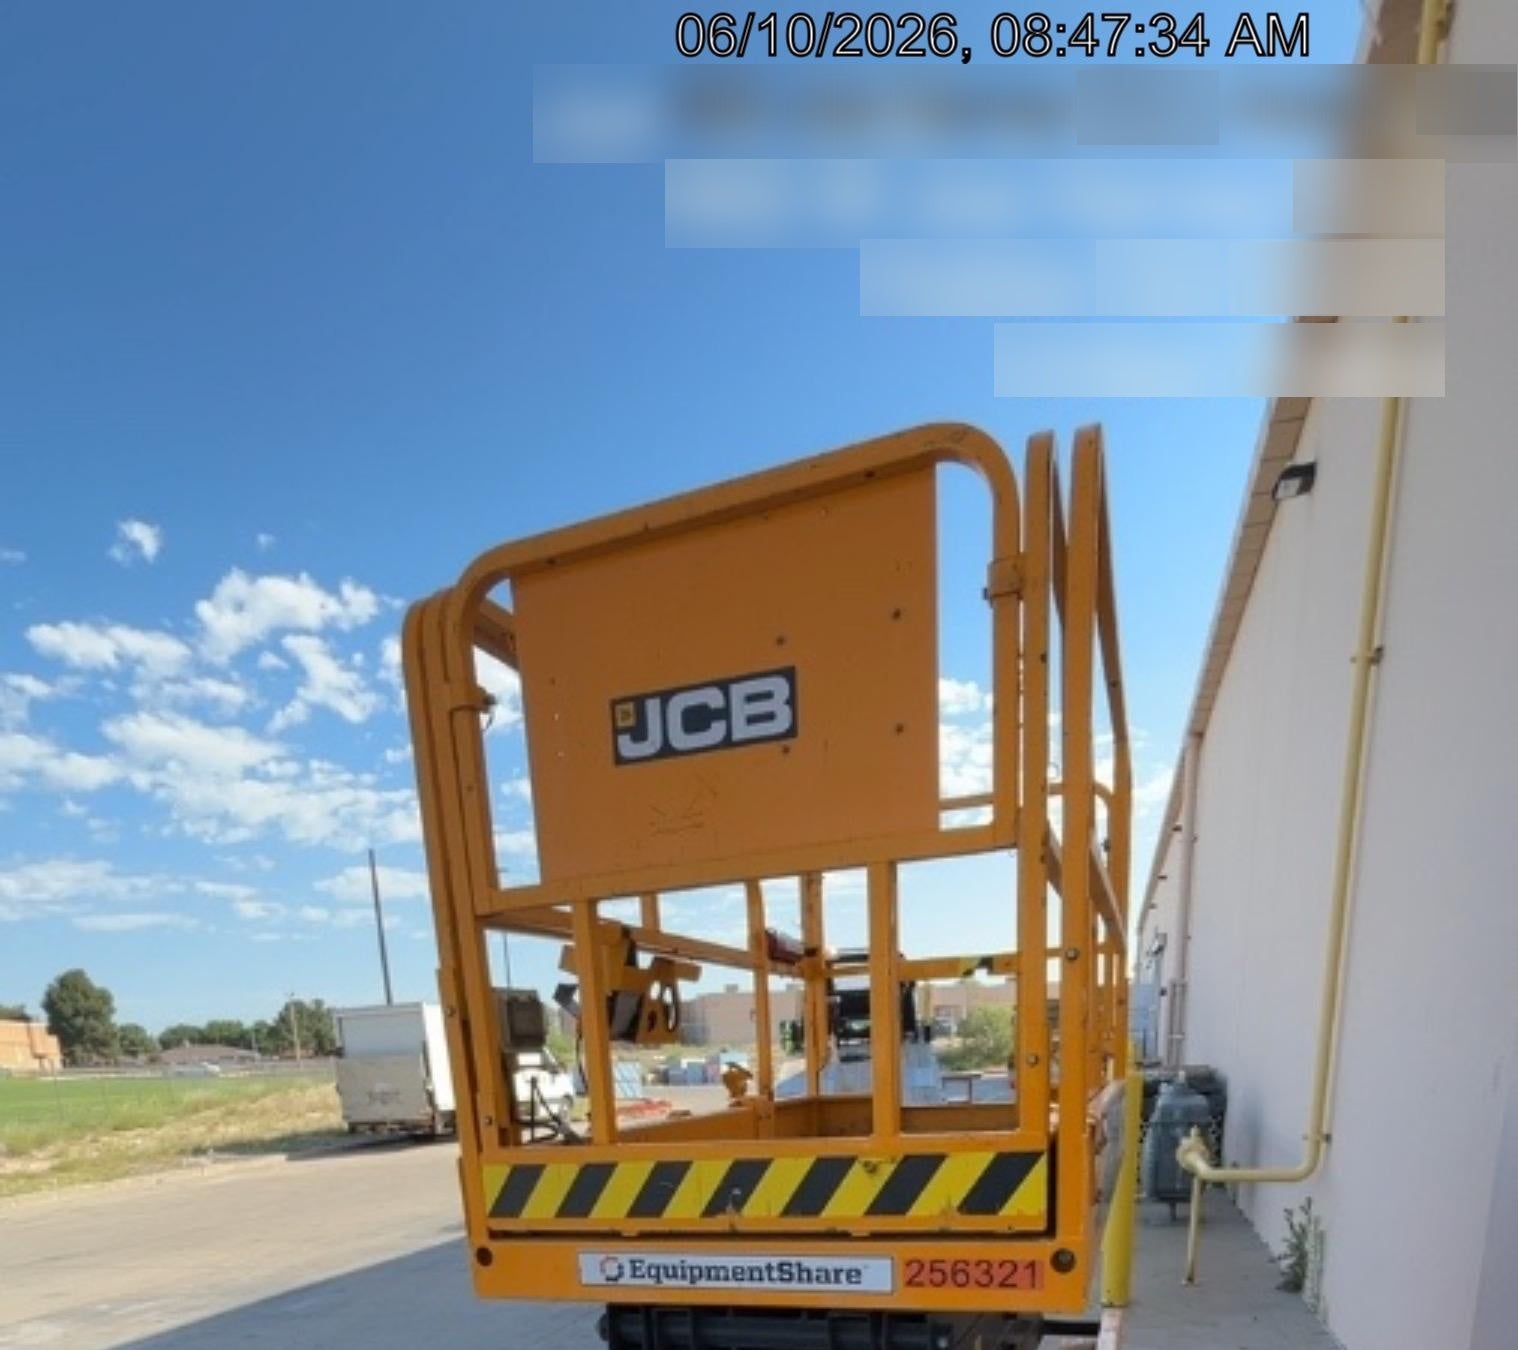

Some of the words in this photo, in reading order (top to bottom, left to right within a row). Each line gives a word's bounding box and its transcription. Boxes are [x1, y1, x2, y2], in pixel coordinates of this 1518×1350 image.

[616, 674, 793, 760] JCB
[628, 1258, 863, 1286] EquipmentShare
[904, 1258, 1042, 1289] 256321
